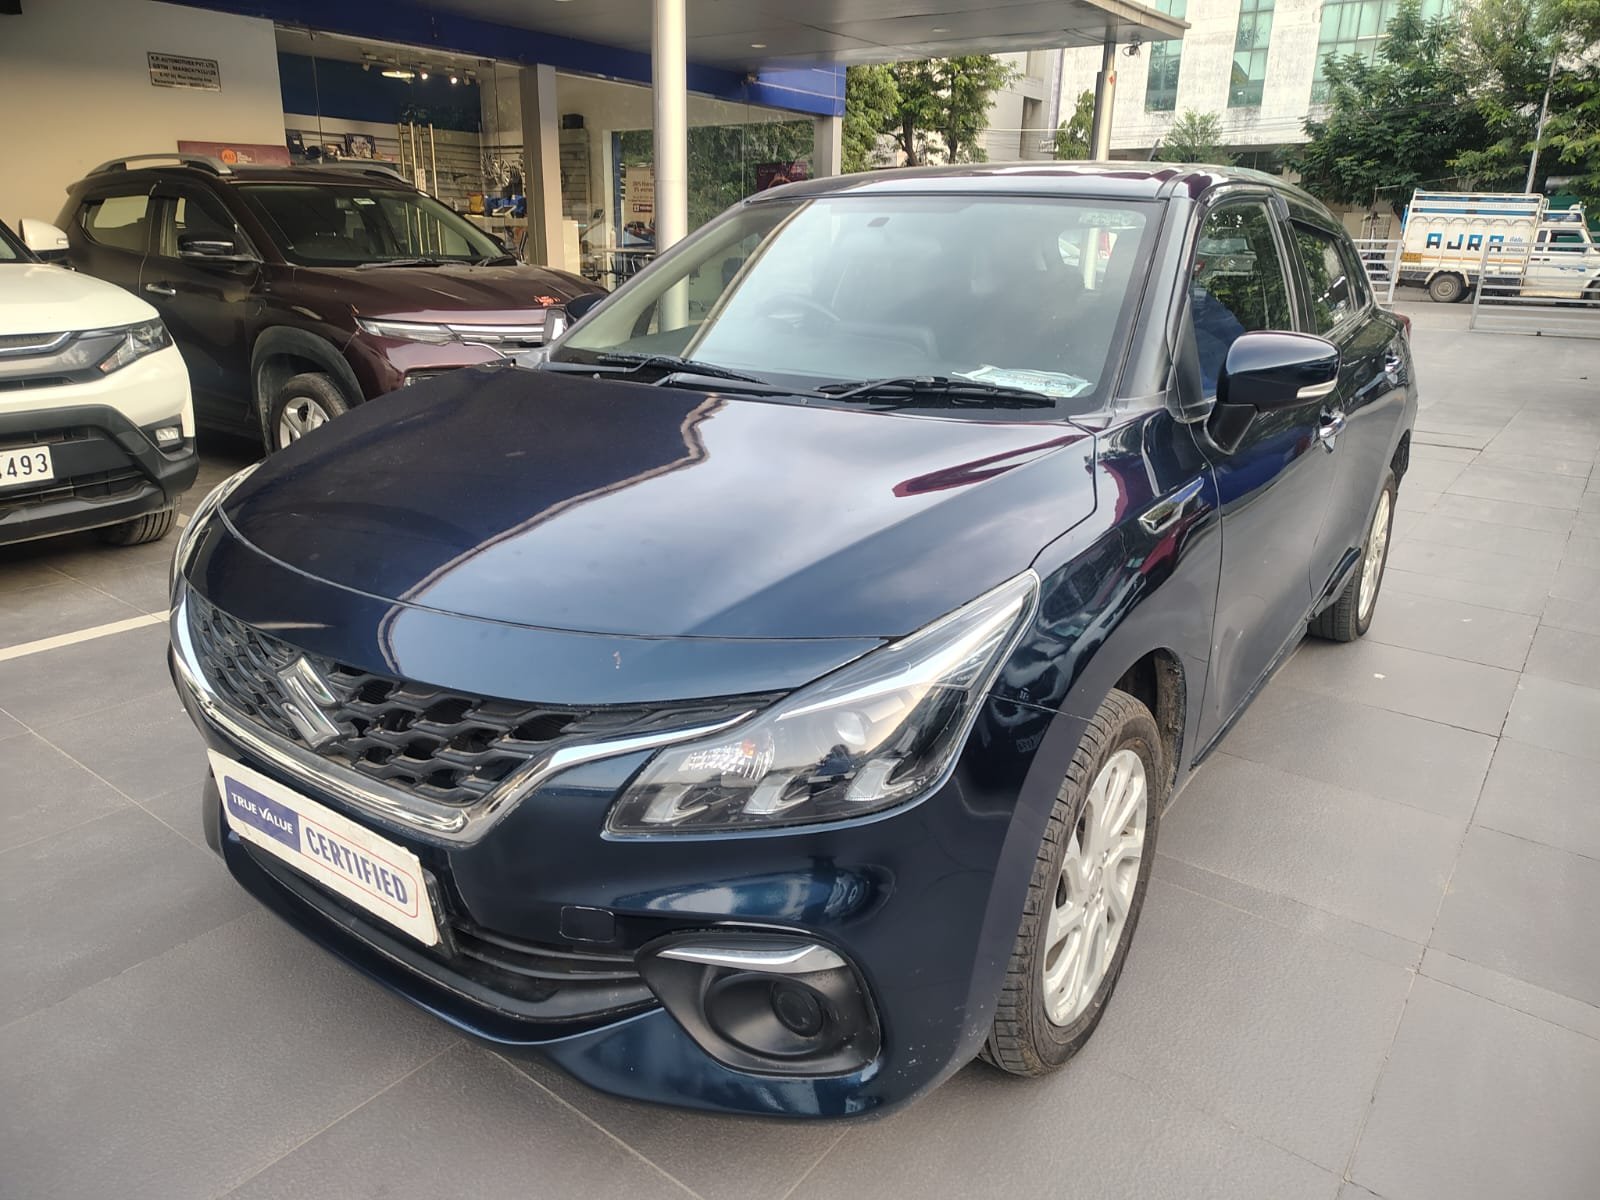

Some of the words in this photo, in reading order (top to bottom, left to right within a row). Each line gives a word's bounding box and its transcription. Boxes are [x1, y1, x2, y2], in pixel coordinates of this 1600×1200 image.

[1426, 232, 1505, 253] AJRA
[0, 453, 48, 479] 493
[231, 792, 258, 816] TRUE
[259, 807, 293, 835] VALUE
[305, 826, 408, 905] CERTIFIED
